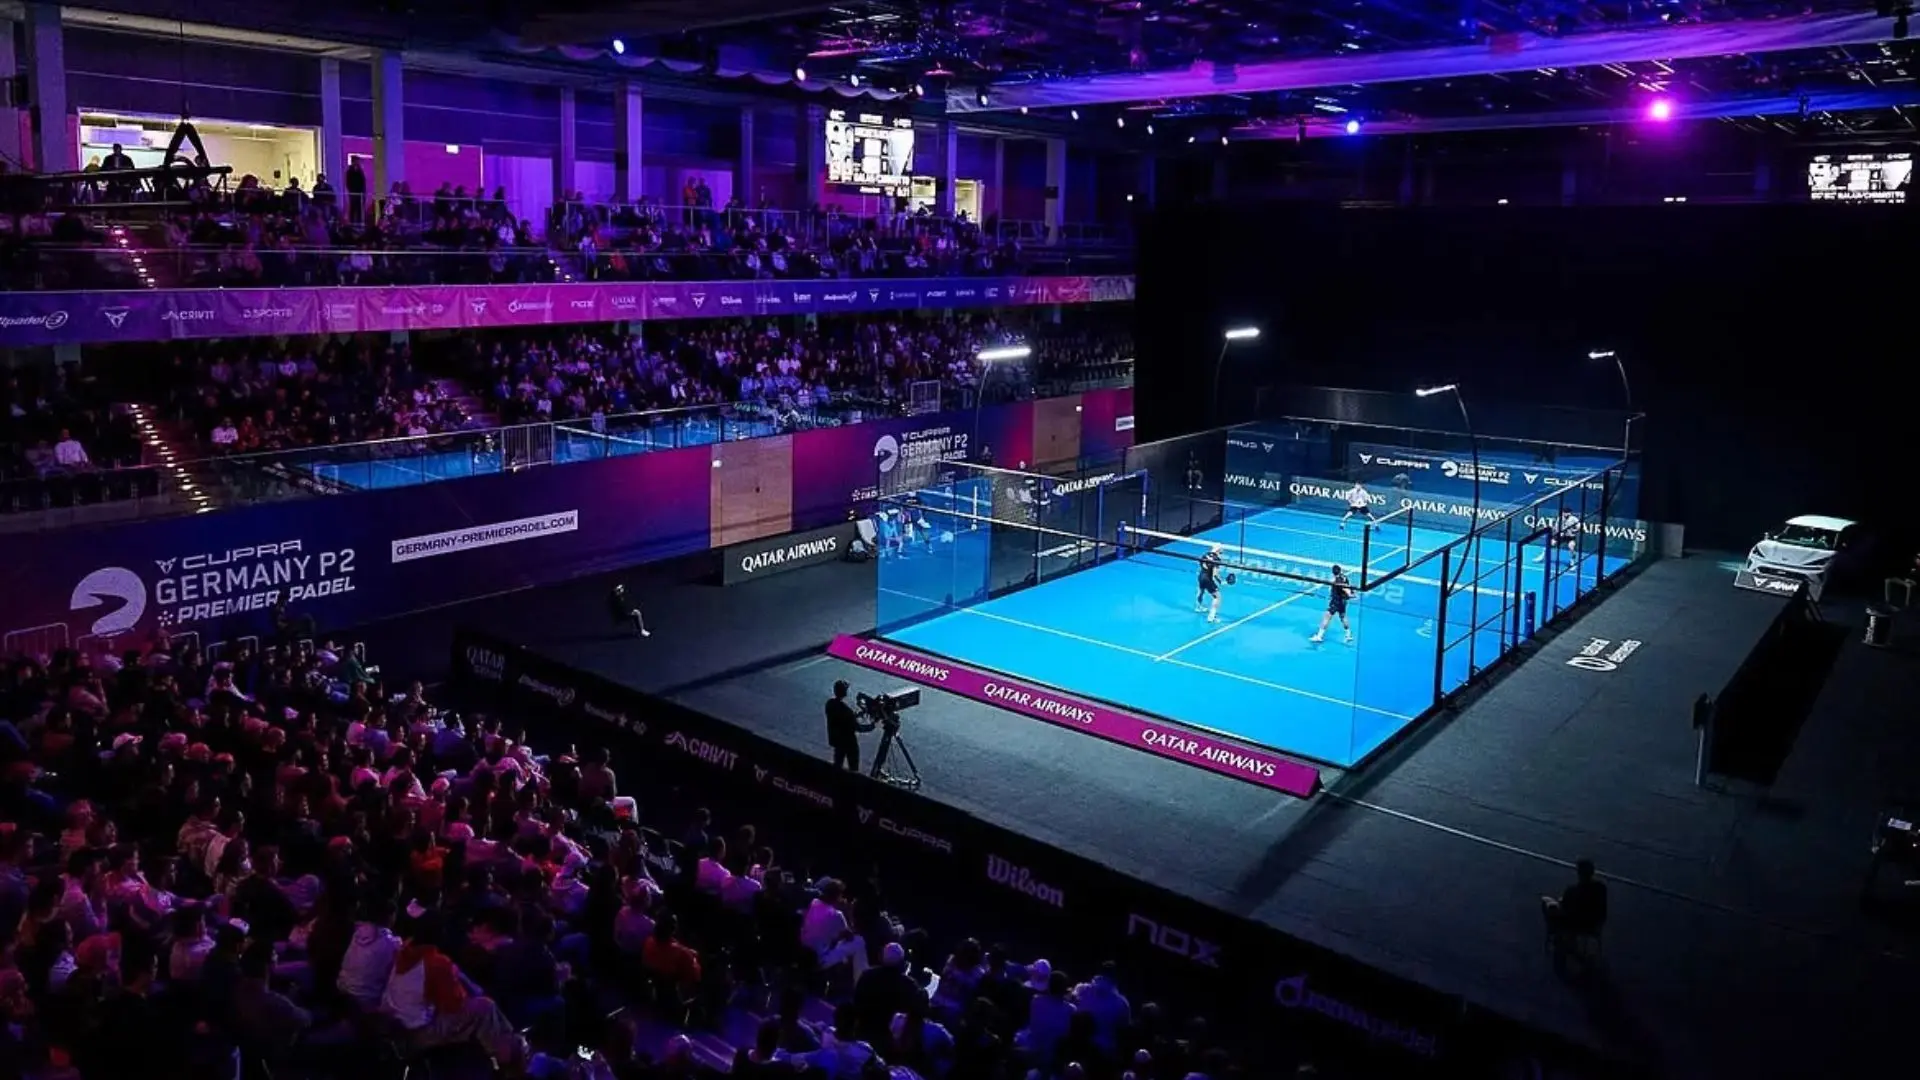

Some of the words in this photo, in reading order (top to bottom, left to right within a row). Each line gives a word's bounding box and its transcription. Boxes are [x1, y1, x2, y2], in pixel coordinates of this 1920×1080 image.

[954, 433, 968, 449] P2
[1289, 482, 1330, 498] QATAR
[1401, 498, 1446, 514] QATAR
[396, 516, 576, 556] GERMANY-PREMIERPADEL.COM
[183, 539, 301, 569] CUPRA
[741, 549, 785, 572] QATAR
[787, 537, 837, 561] AIRWAYS
[156, 558, 311, 604] GERMANY
[320, 548, 356, 575] P2
[177, 594, 280, 624] PREMIER
[288, 576, 356, 603] PADEL
[466, 646, 506, 667] QATAR
[855, 645, 897, 666] QATAR
[896, 656, 949, 681] AIRWAYS
[983, 682, 1031, 707] QATAR
[1031, 696, 1095, 724] AIRWAYS
[688, 738, 740, 772] CRIVIT
[1141, 728, 1198, 755] QATAR
[1199, 744, 1276, 778] AIRWAYS
[772, 775, 834, 809] CUPRA
[879, 816, 953, 855] CUPRA
[986, 851, 1065, 909] Wilson
